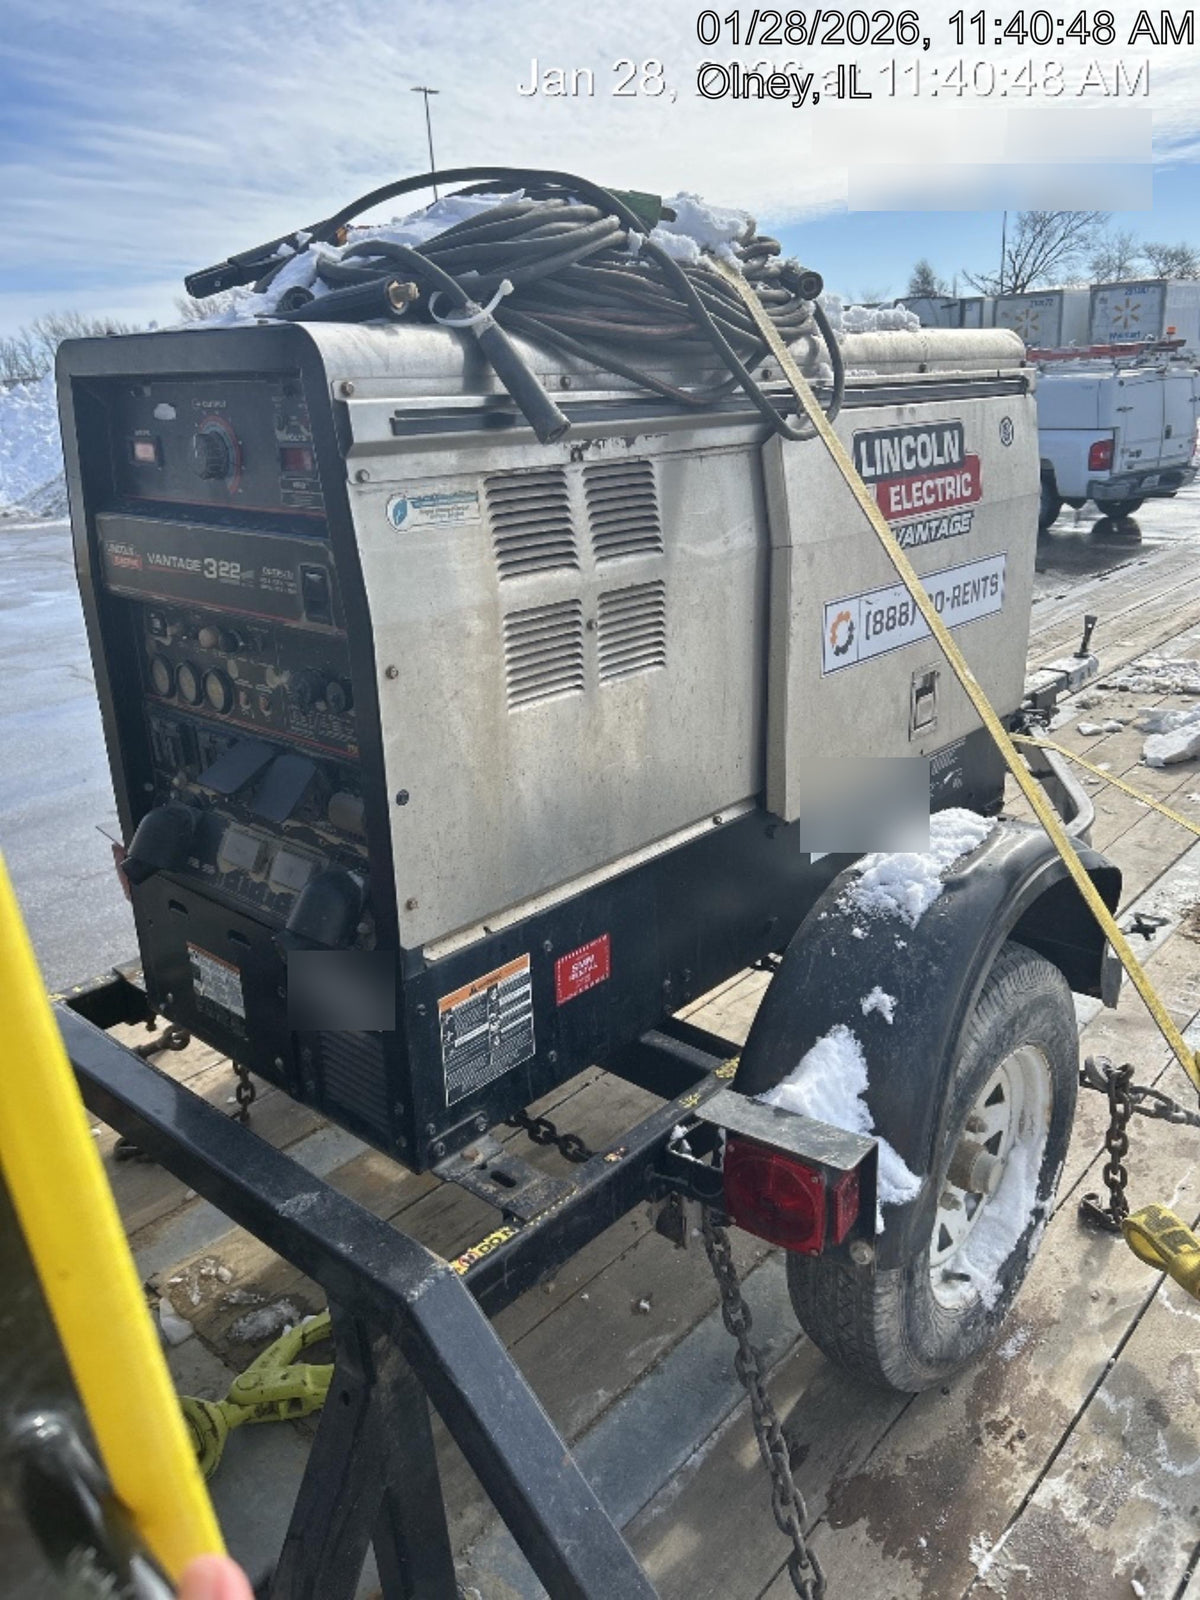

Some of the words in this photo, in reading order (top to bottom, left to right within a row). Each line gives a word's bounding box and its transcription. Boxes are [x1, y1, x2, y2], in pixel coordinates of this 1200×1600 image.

[860, 429, 961, 478] LINCOLN
[889, 472, 972, 512] ELECTRIC
[892, 510, 975, 549] VANTAGE
[147, 553, 201, 572] VANTAGE
[203, 557, 241, 580] 322
[927, 572, 999, 614] 0-RENTS
